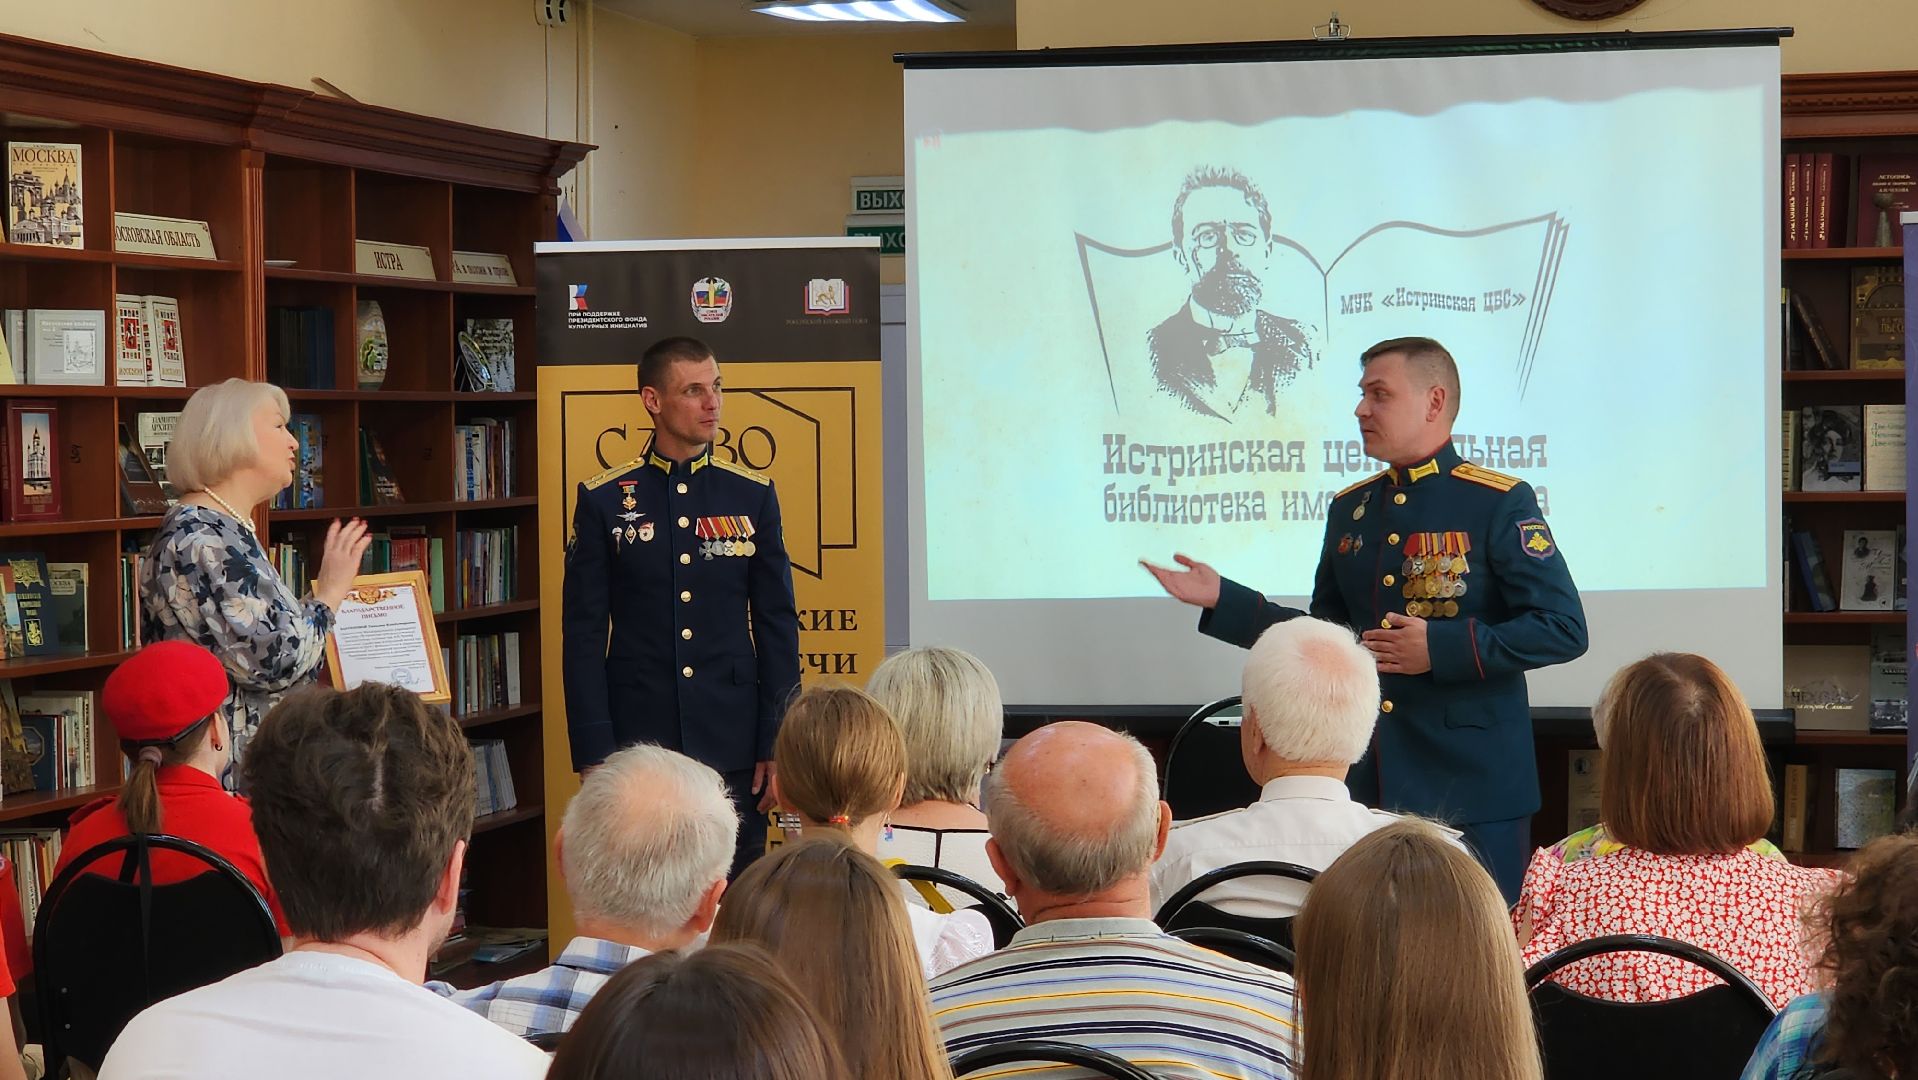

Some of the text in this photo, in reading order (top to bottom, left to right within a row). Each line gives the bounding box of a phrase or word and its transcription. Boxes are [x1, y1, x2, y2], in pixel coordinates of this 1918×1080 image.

[13, 148, 76, 164] МОСКВА
[860, 191, 905, 208] ВЫХ
[115, 225, 201, 248] ОСКОВСКАЯ ОБЛАСТЬ
[373, 251, 404, 271] ИСТРА
[1340, 287, 1527, 315] МУК «Истринская ЦБС»
[596, 424, 776, 470] СВО
[1103, 434, 1547, 486] Истринская цельная
[1104, 482, 1266, 525] библиотека
